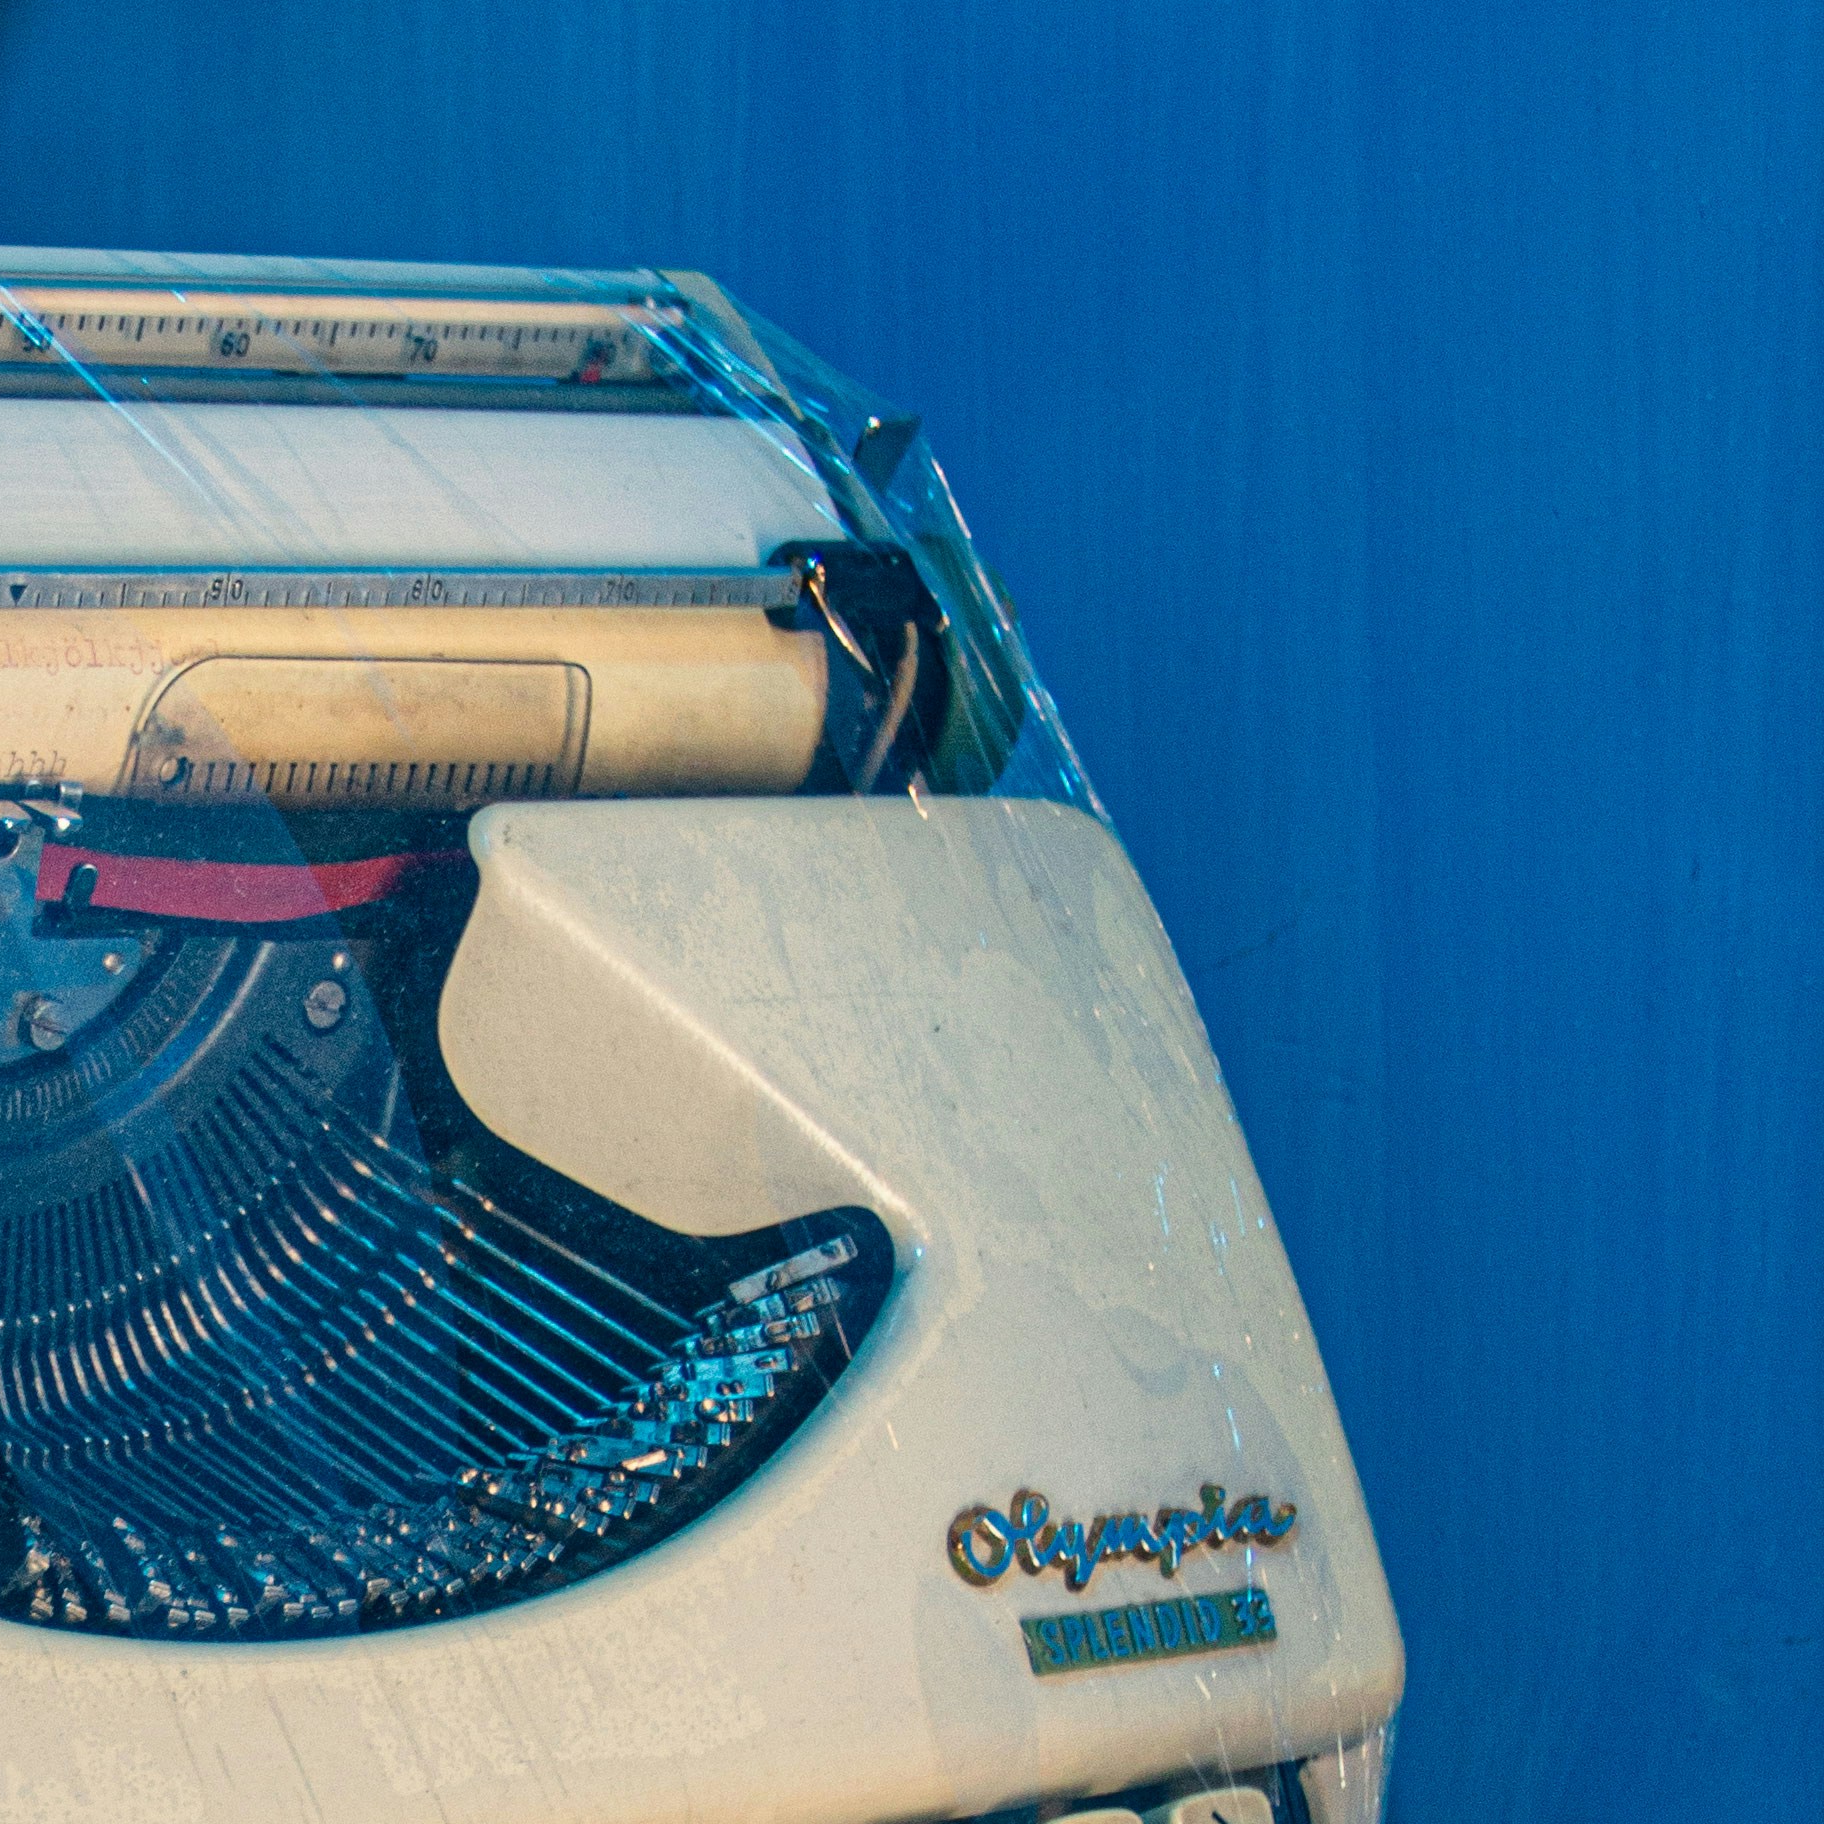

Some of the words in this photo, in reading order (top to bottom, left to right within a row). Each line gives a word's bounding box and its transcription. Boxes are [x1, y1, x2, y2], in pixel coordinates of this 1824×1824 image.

[220, 331, 251, 358] 60
[410, 336, 439, 363] 70
[947, 1484, 1298, 1592] Olympia
[1039, 1599, 1222, 1666] SPLENDID
[1231, 1592, 1275, 1636] 33
